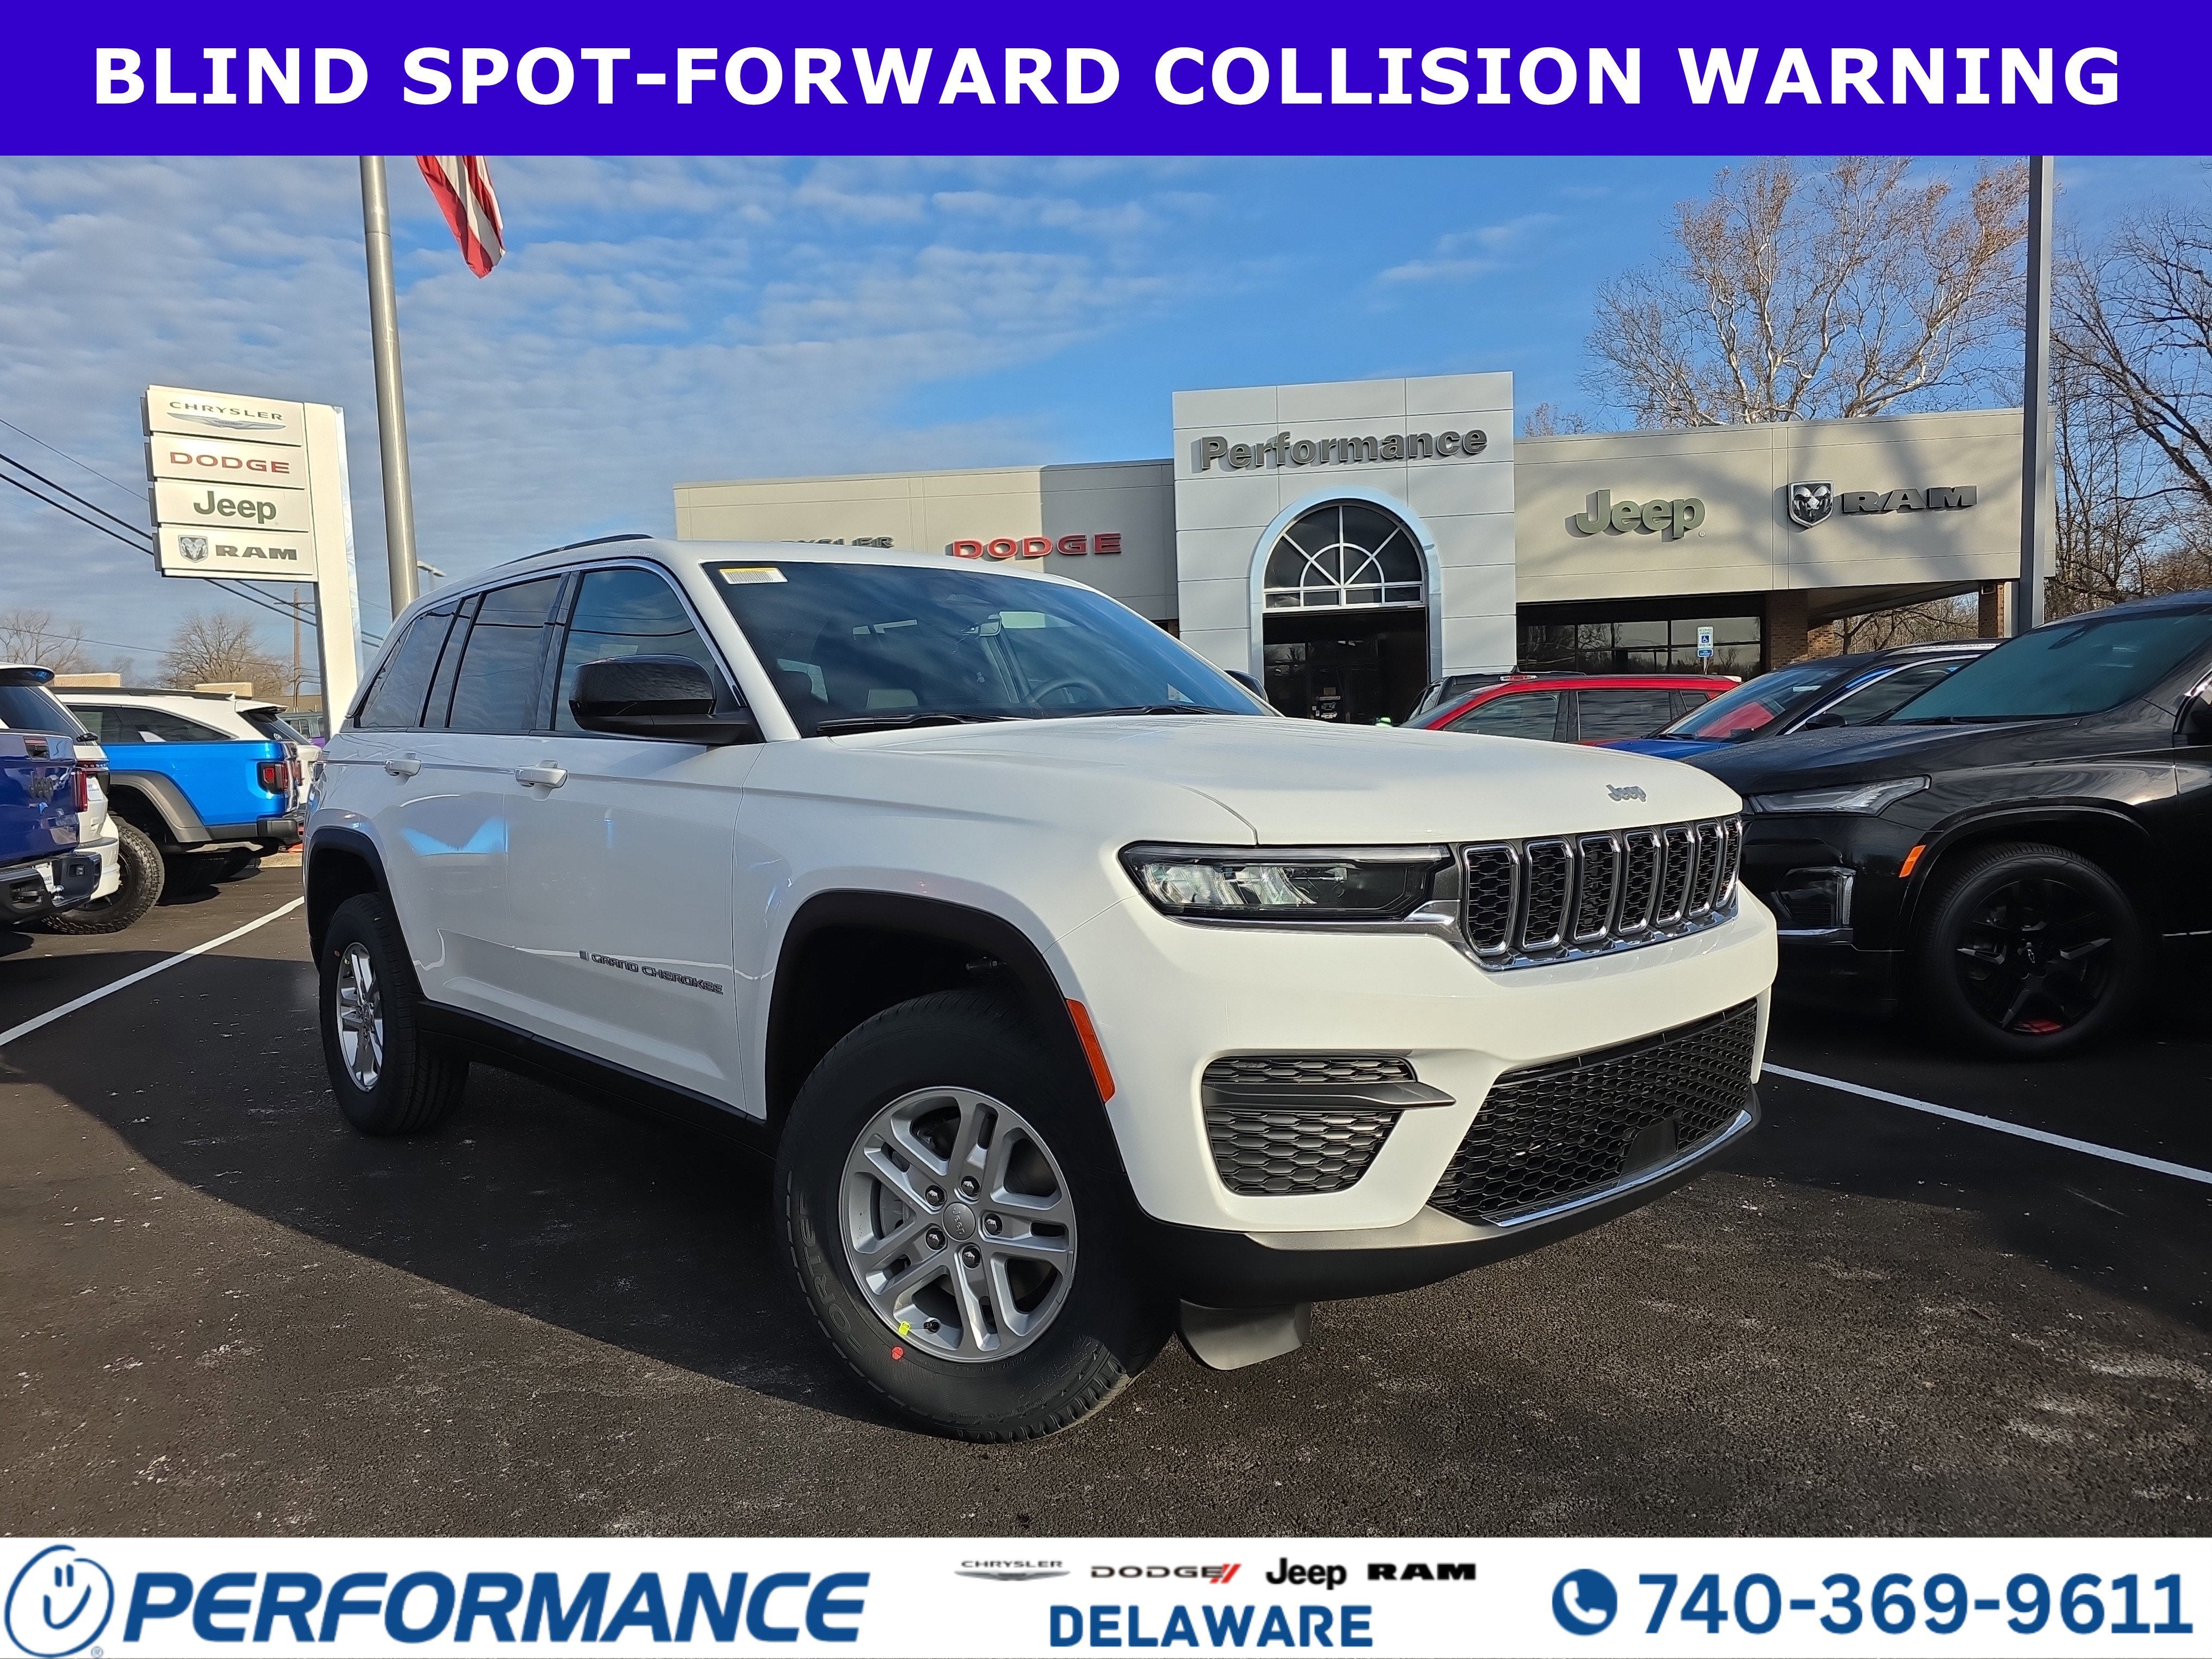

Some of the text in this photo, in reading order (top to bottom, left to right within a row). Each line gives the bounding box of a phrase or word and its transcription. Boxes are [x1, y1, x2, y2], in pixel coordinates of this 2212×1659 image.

[169, 402, 284, 421] CHRYSLER
[1201, 428, 1488, 470] Performance
[170, 452, 290, 474] DODGE
[193, 490, 276, 525] Jeep
[1842, 485, 1978, 514] RAM
[1576, 489, 1706, 538] Jeep
[215, 544, 297, 561] RAM
[953, 532, 1122, 559] DODGE
[1606, 784, 1647, 802] Jeep
[591, 953, 724, 995] GRAND CHEROKEE
[952, 1207, 965, 1234] Jeep
